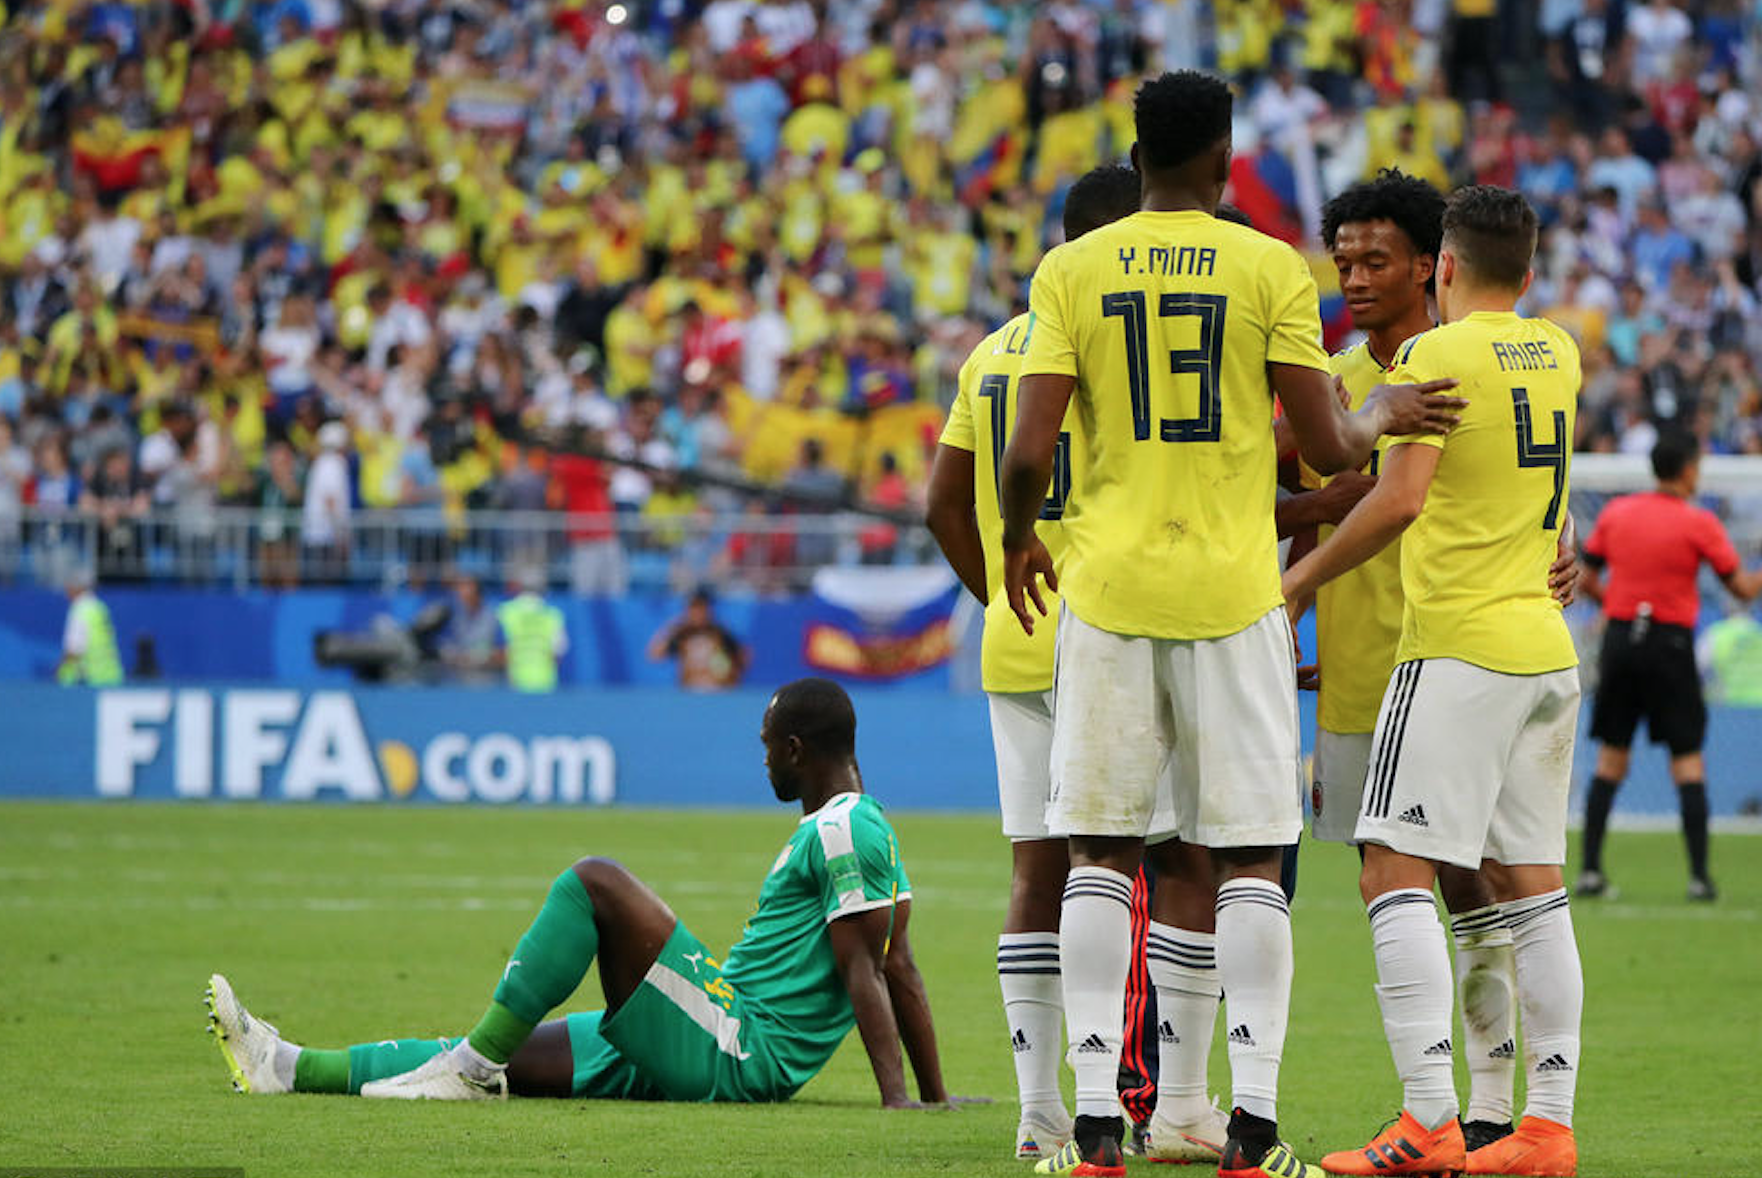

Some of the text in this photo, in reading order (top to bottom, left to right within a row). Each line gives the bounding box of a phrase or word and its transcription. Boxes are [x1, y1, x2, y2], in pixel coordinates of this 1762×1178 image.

[1119, 246, 1217, 276] Y.MINA
[1102, 290, 1228, 442] 13
[1491, 341, 1557, 371] ARIAS
[1511, 387, 1566, 529] 4
[95, 689, 616, 803] FIFA.com
